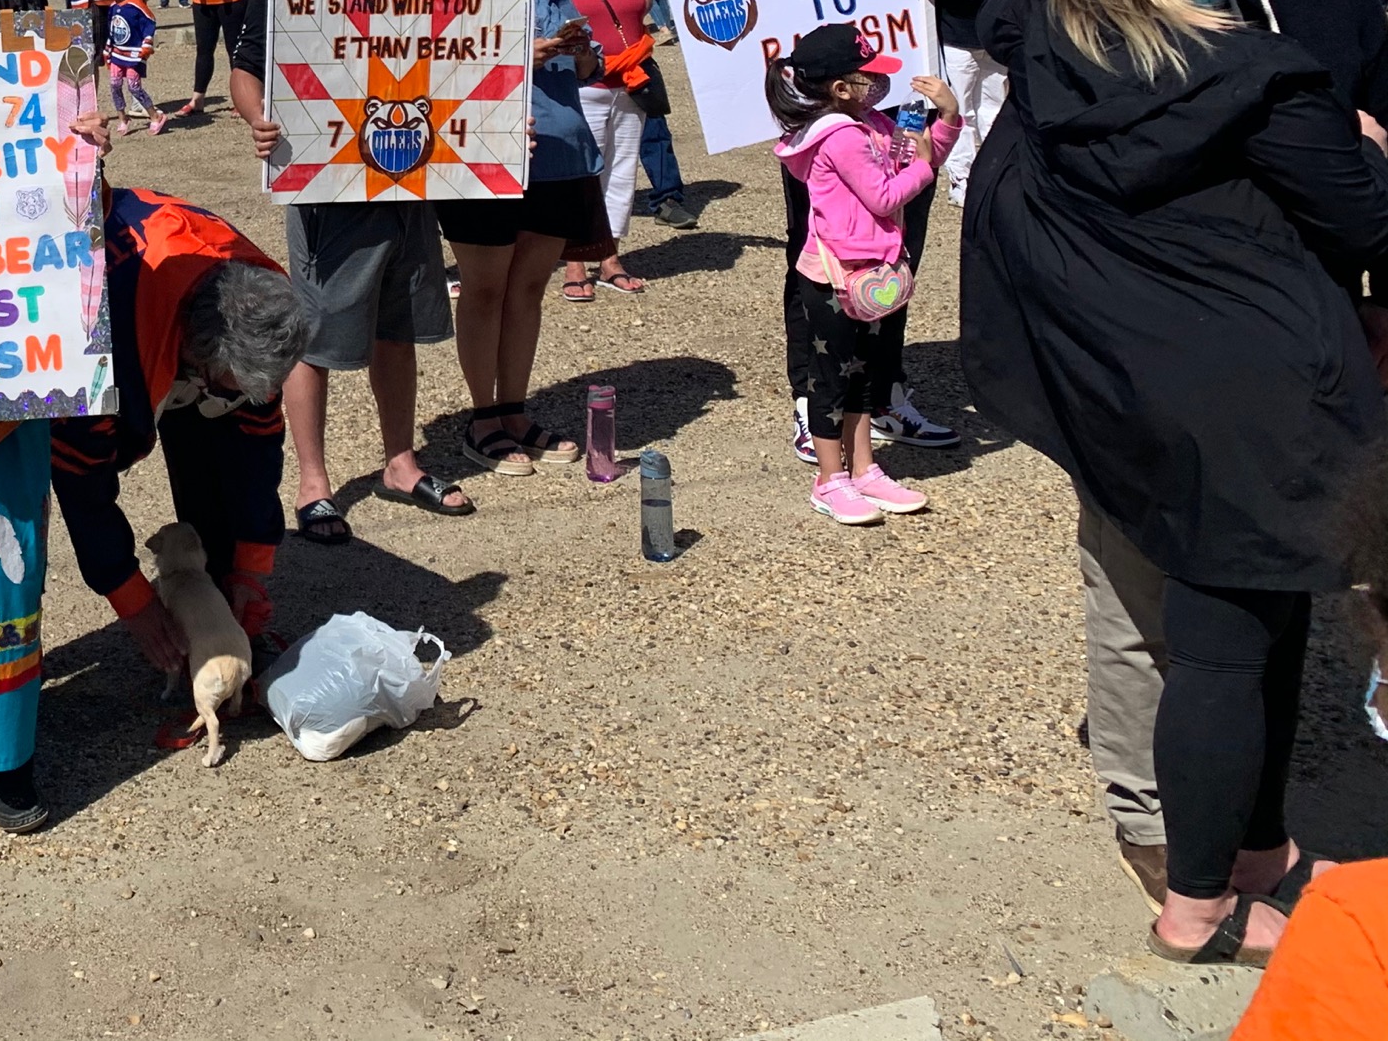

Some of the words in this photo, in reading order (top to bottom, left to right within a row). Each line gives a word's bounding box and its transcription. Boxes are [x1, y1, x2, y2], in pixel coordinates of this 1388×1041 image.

[333, 35, 410, 60] ETHAN
[416, 25, 502, 60] BEAR!!
[760, 9, 919, 69] RSM
[326, 120, 344, 148] 7
[449, 119, 467, 148] 4
[371, 129, 424, 173] OILERS
